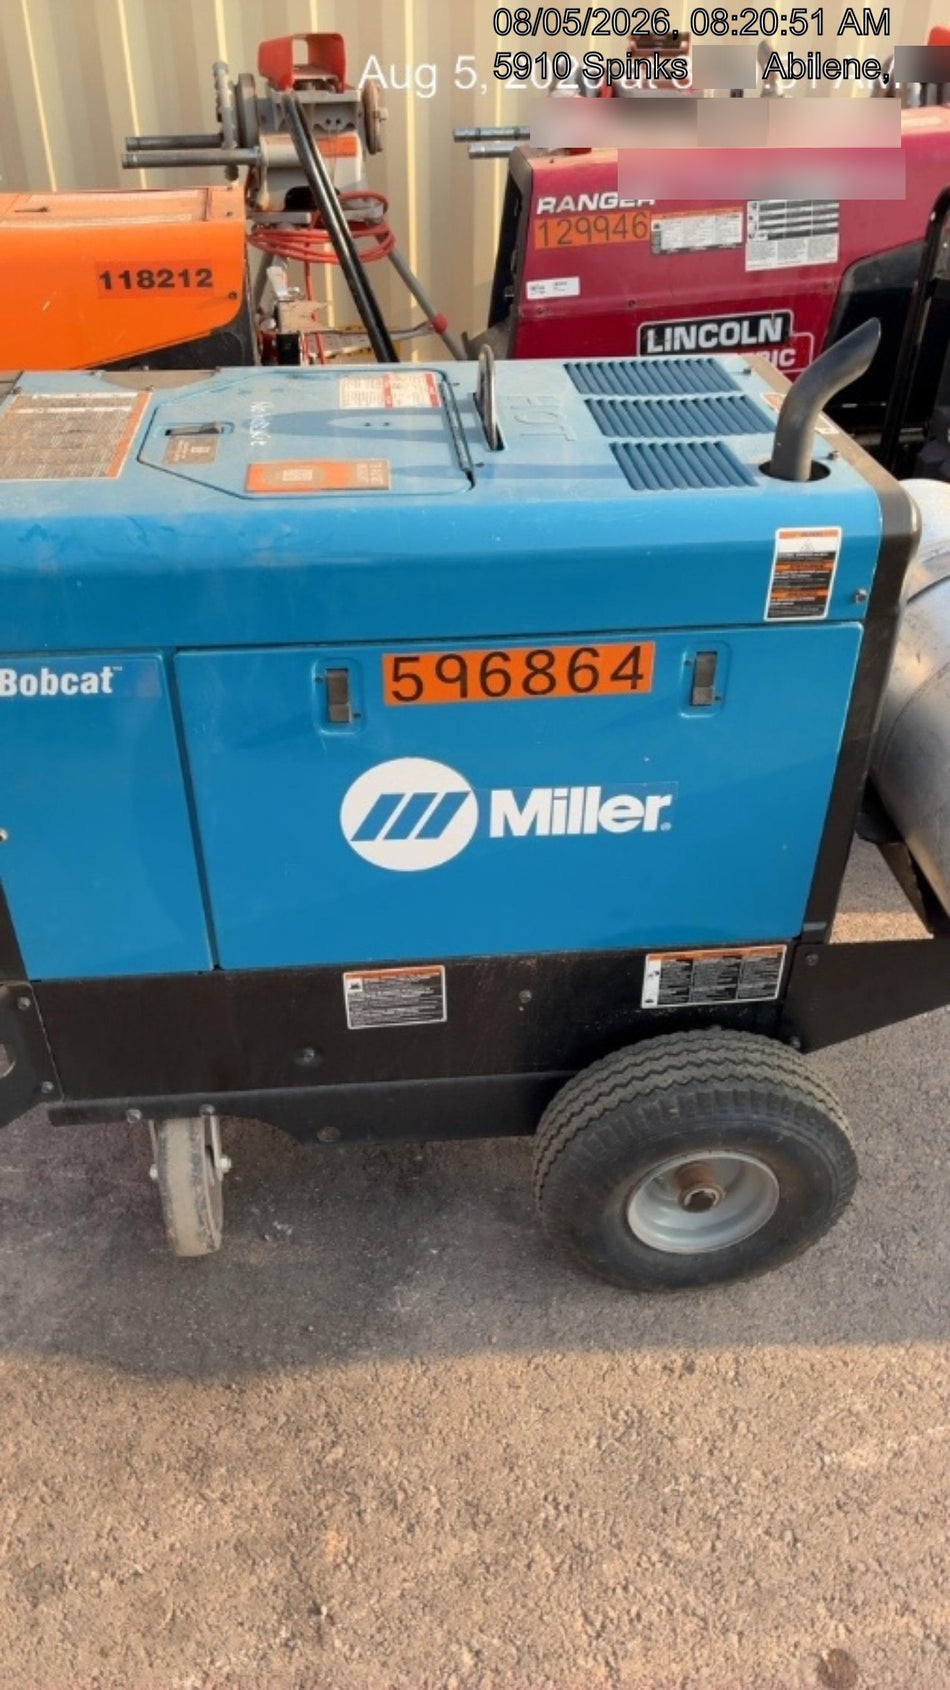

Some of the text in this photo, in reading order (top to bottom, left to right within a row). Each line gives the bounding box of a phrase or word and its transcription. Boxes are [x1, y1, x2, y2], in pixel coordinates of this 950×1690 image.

[536, 192, 656, 215] RANG
[538, 212, 649, 247] 129946
[99, 267, 214, 290] 118212
[646, 316, 784, 354] LINCOLN
[391, 645, 645, 702] 596864
